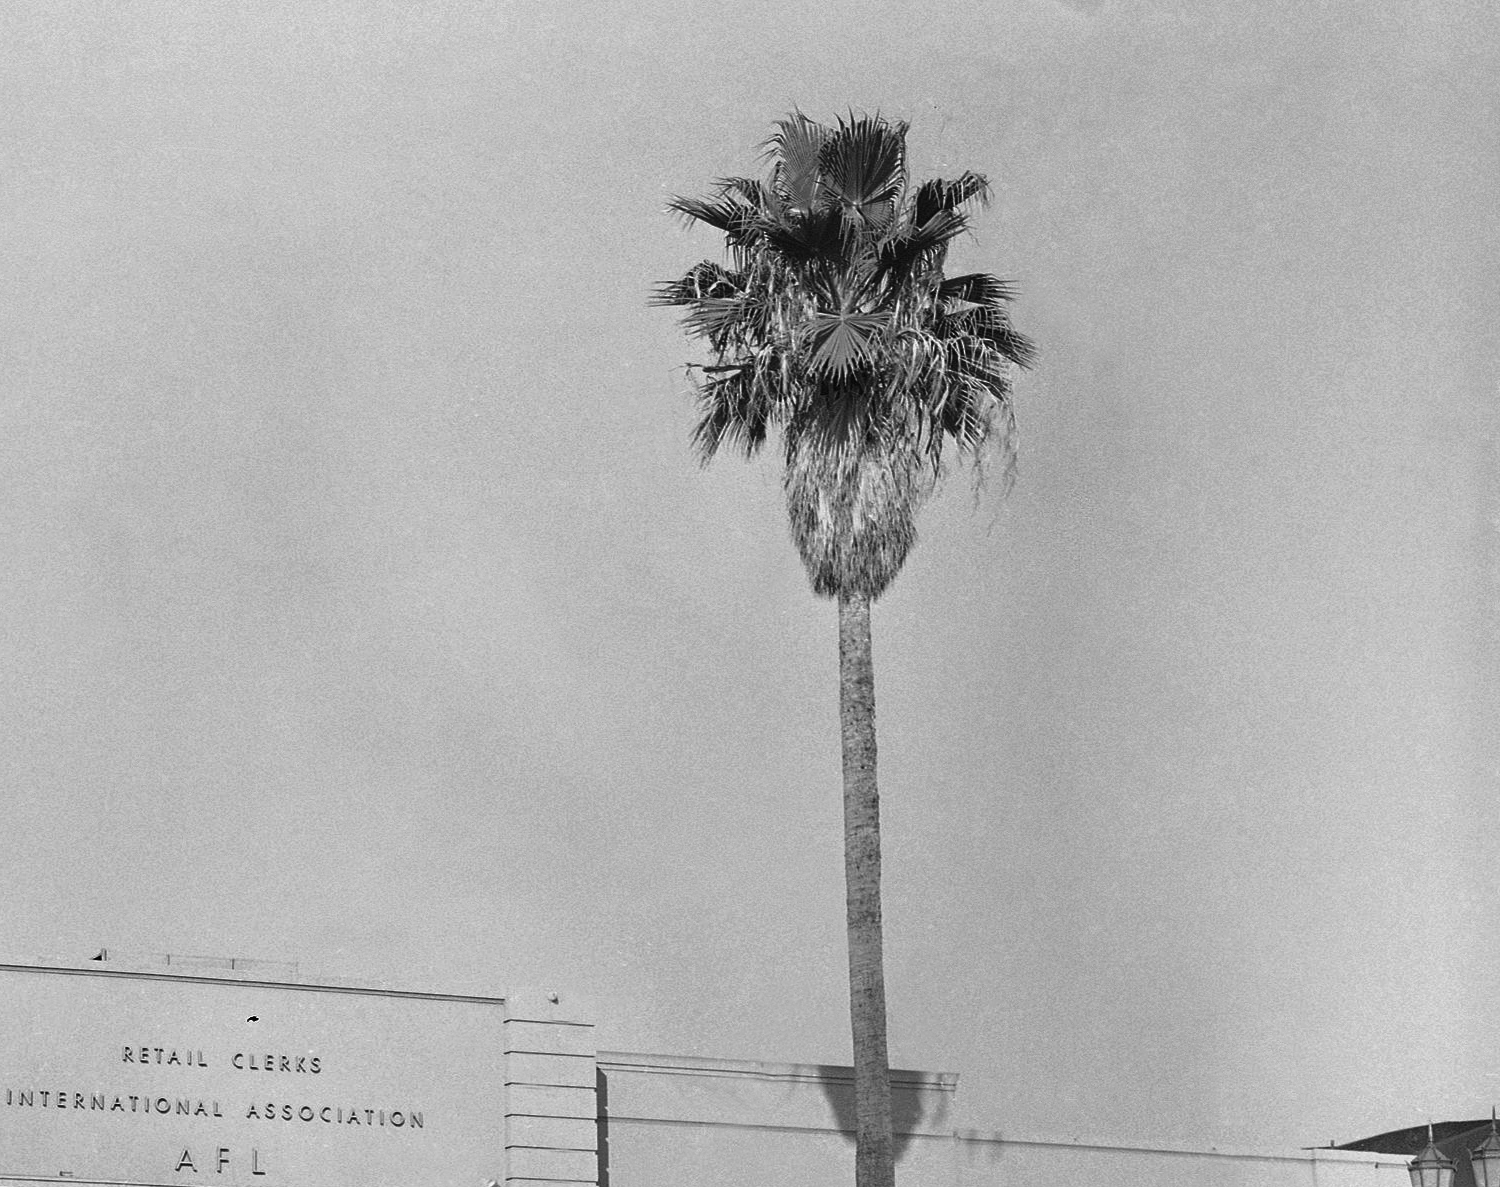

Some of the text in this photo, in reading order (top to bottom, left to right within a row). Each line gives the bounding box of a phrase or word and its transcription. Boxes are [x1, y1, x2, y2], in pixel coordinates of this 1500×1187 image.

[122, 1046, 322, 1074] RETAIL CLERKS
[6, 1088, 424, 1129] INTERNATIONAL ASSOCIATION
